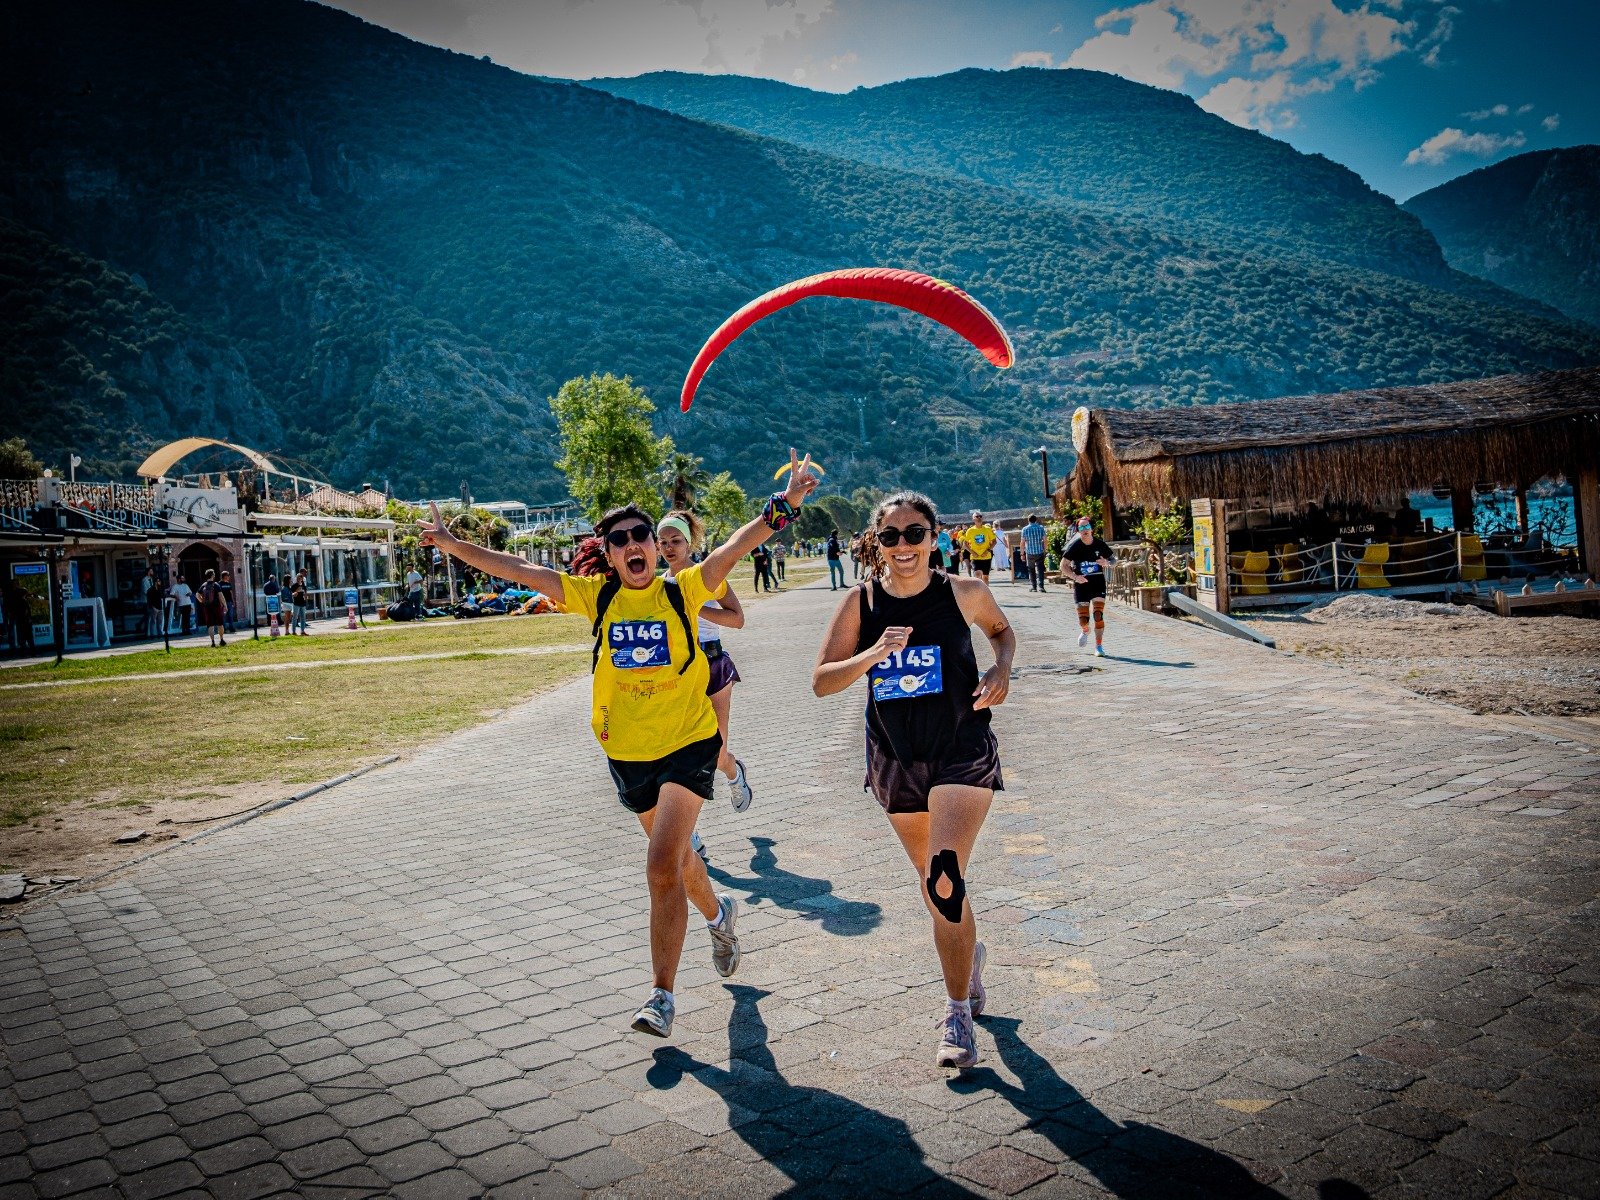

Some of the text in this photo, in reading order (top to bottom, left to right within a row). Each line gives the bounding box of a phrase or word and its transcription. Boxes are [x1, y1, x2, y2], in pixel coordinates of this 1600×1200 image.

[0, 508, 33, 528] LUE
[95, 510, 128, 528] DEEP
[132, 510, 160, 528] BLUE
[612, 623, 663, 642] 5146
[877, 648, 936, 669] 5145
